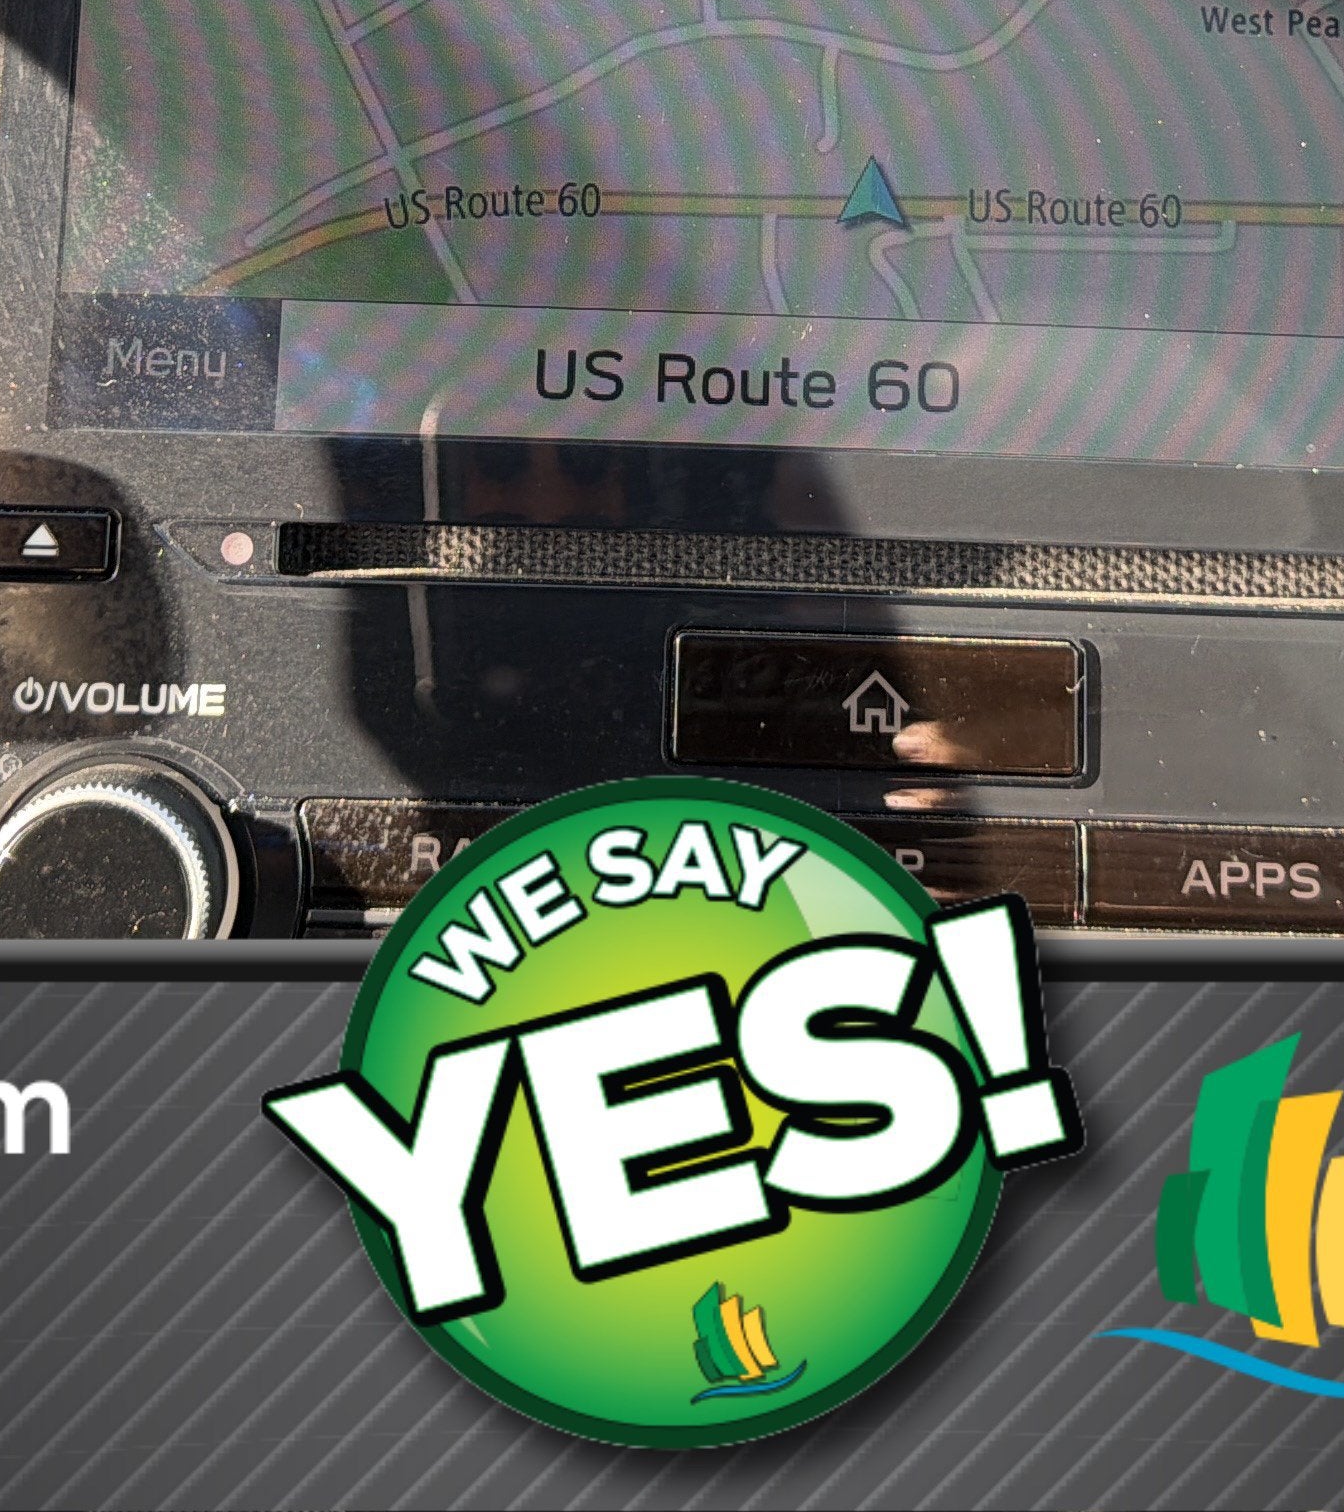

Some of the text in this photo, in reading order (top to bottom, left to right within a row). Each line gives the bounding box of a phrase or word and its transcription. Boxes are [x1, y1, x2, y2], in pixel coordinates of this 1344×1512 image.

[1201, 6, 1274, 37] West
[1288, 9, 1341, 39] Pea
[383, 182, 602, 231] US Route 60
[967, 189, 1182, 230] US Route 60
[106, 337, 227, 379] Menu
[534, 348, 961, 414] US Route 60
[1181, 858, 1321, 899] APPS
